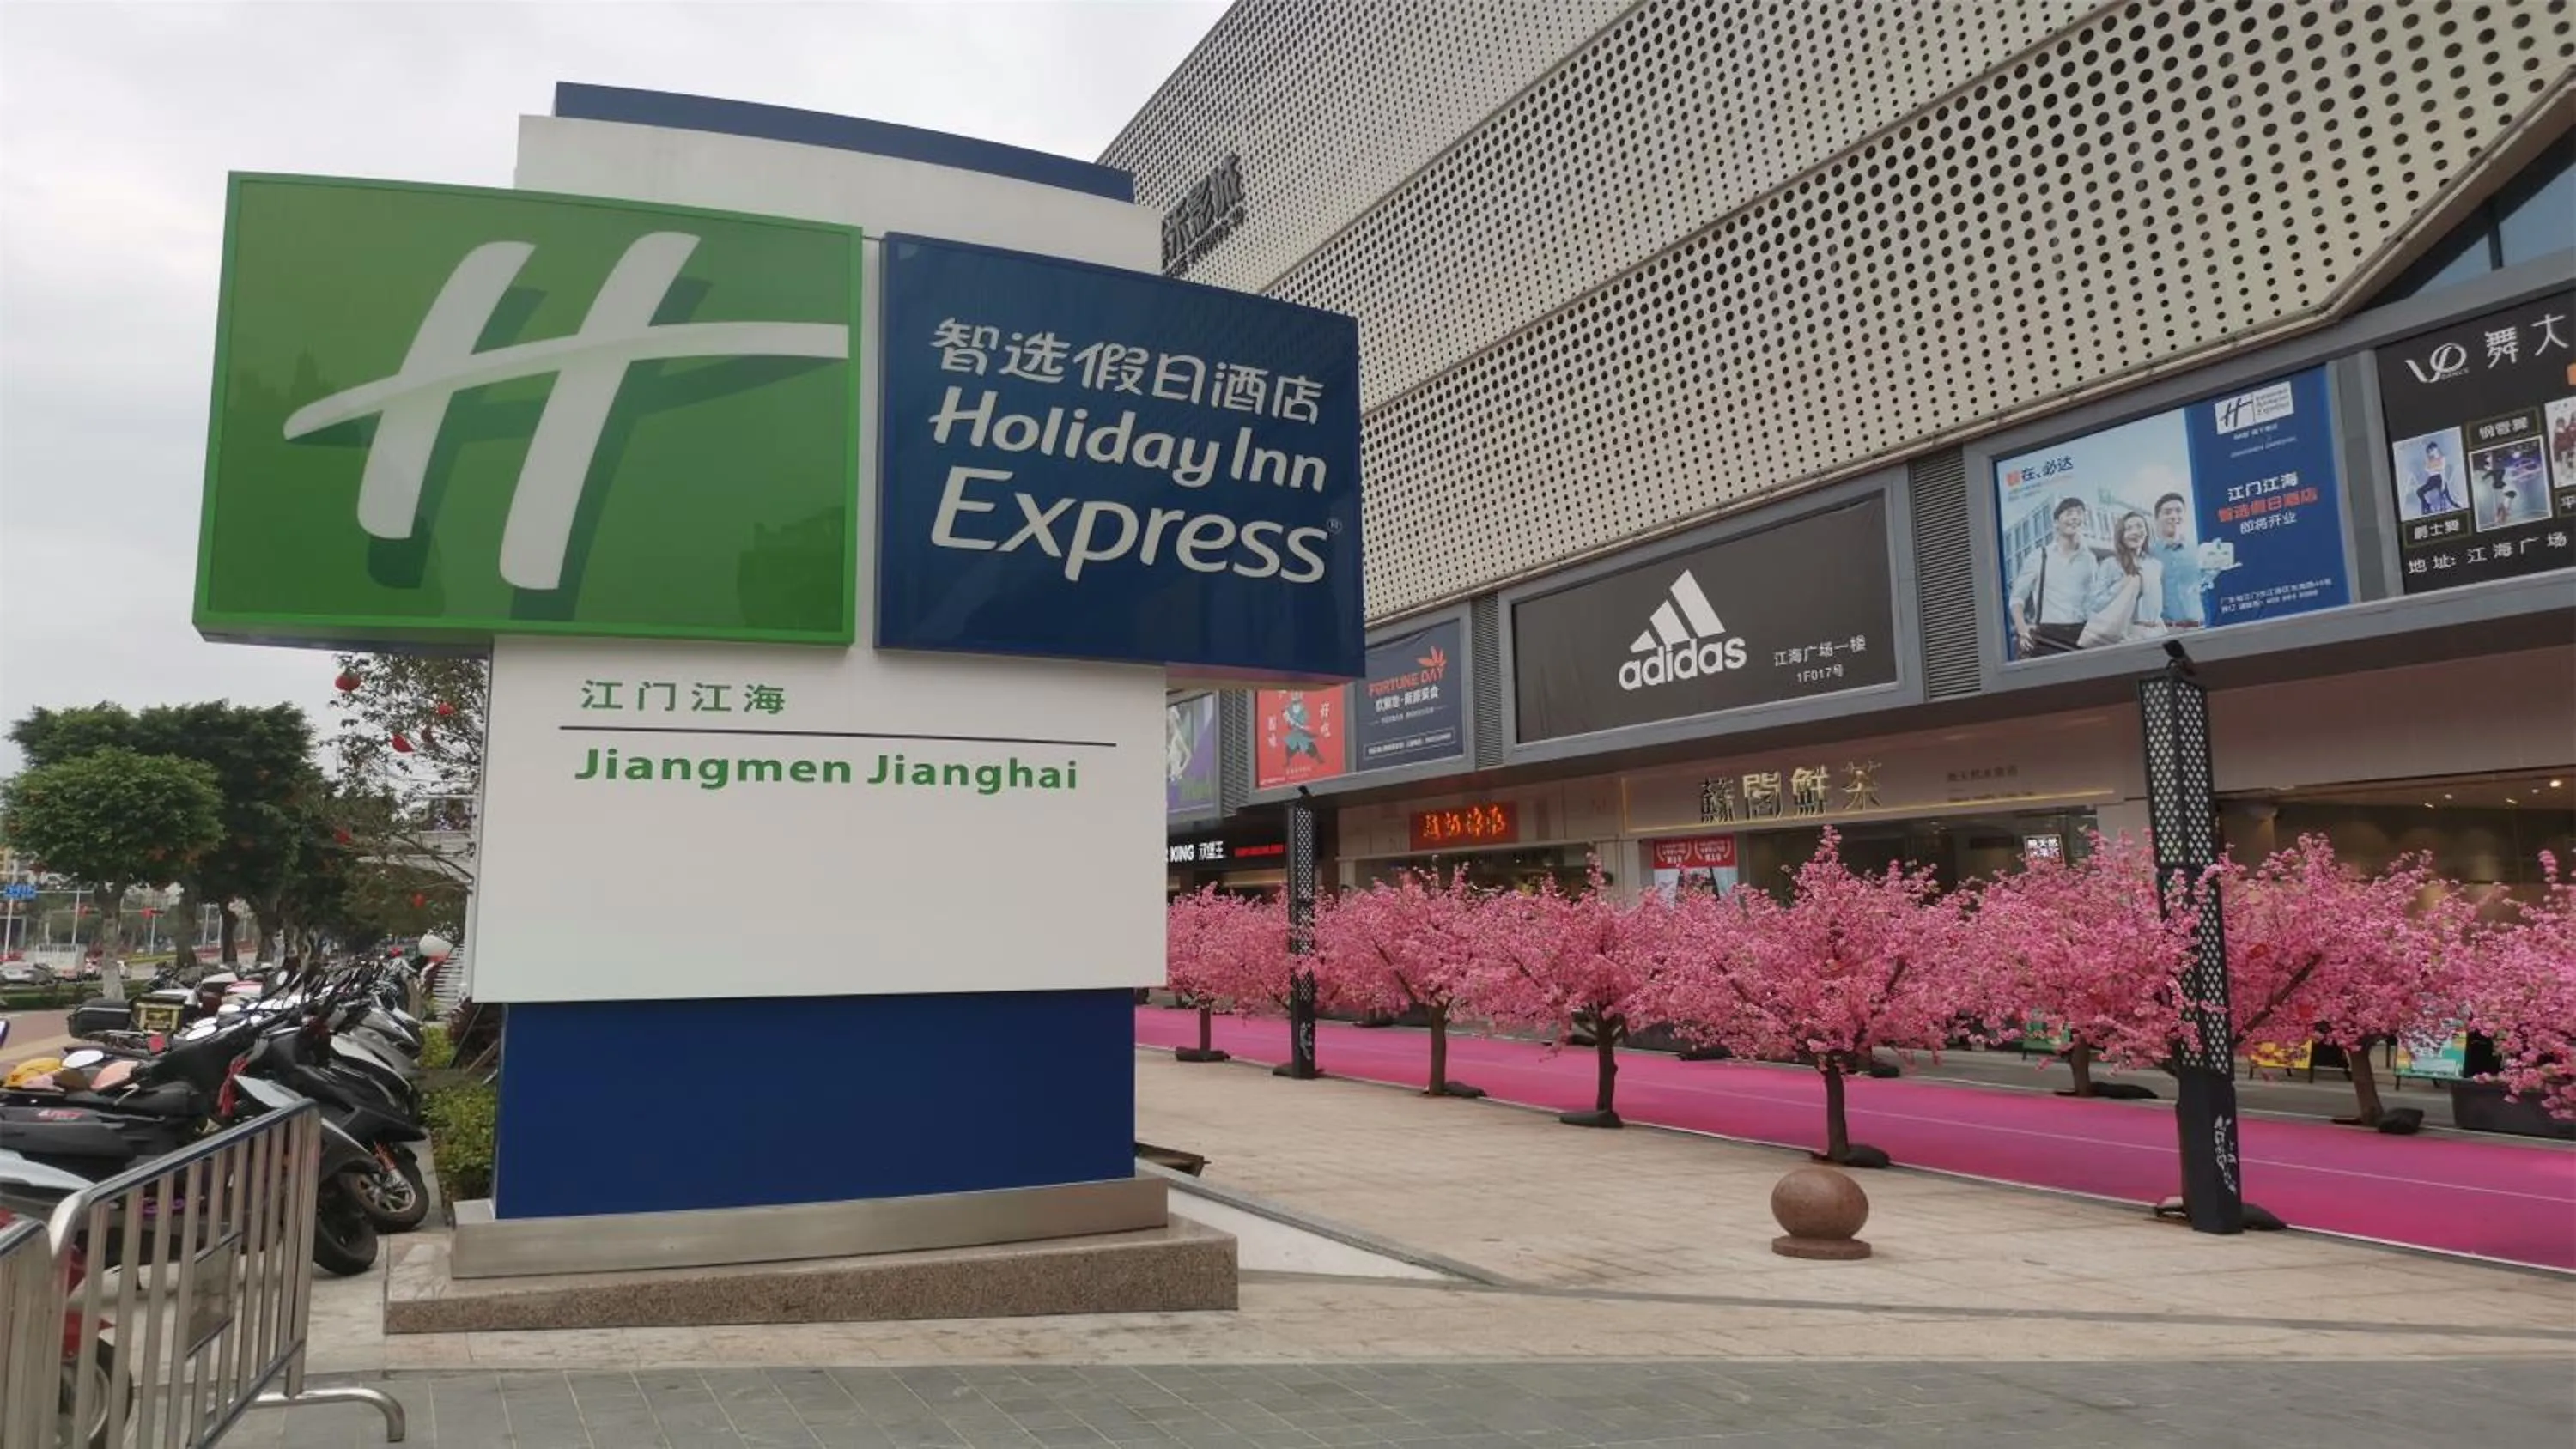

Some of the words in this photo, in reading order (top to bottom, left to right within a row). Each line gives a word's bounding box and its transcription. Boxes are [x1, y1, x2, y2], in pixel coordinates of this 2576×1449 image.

[930, 317, 1325, 426] 智选假日酒店
[928, 385, 1221, 488] Holiday
[1230, 427, 1327, 494] Inn
[2227, 471, 2300, 502] 江门江海
[930, 465, 1329, 584] Express
[2239, 511, 2298, 535] 即将开业
[1619, 636, 1747, 691] adidas
[1773, 634, 1866, 667] 江海广场一楼
[581, 679, 786, 715] 江门江海
[1369, 671, 1419, 699] FORTUNE
[1421, 667, 1444, 684] DAY
[574, 748, 852, 791] Jiangmen
[866, 755, 1077, 795] Jianghai
[1169, 843, 1194, 863] KING
